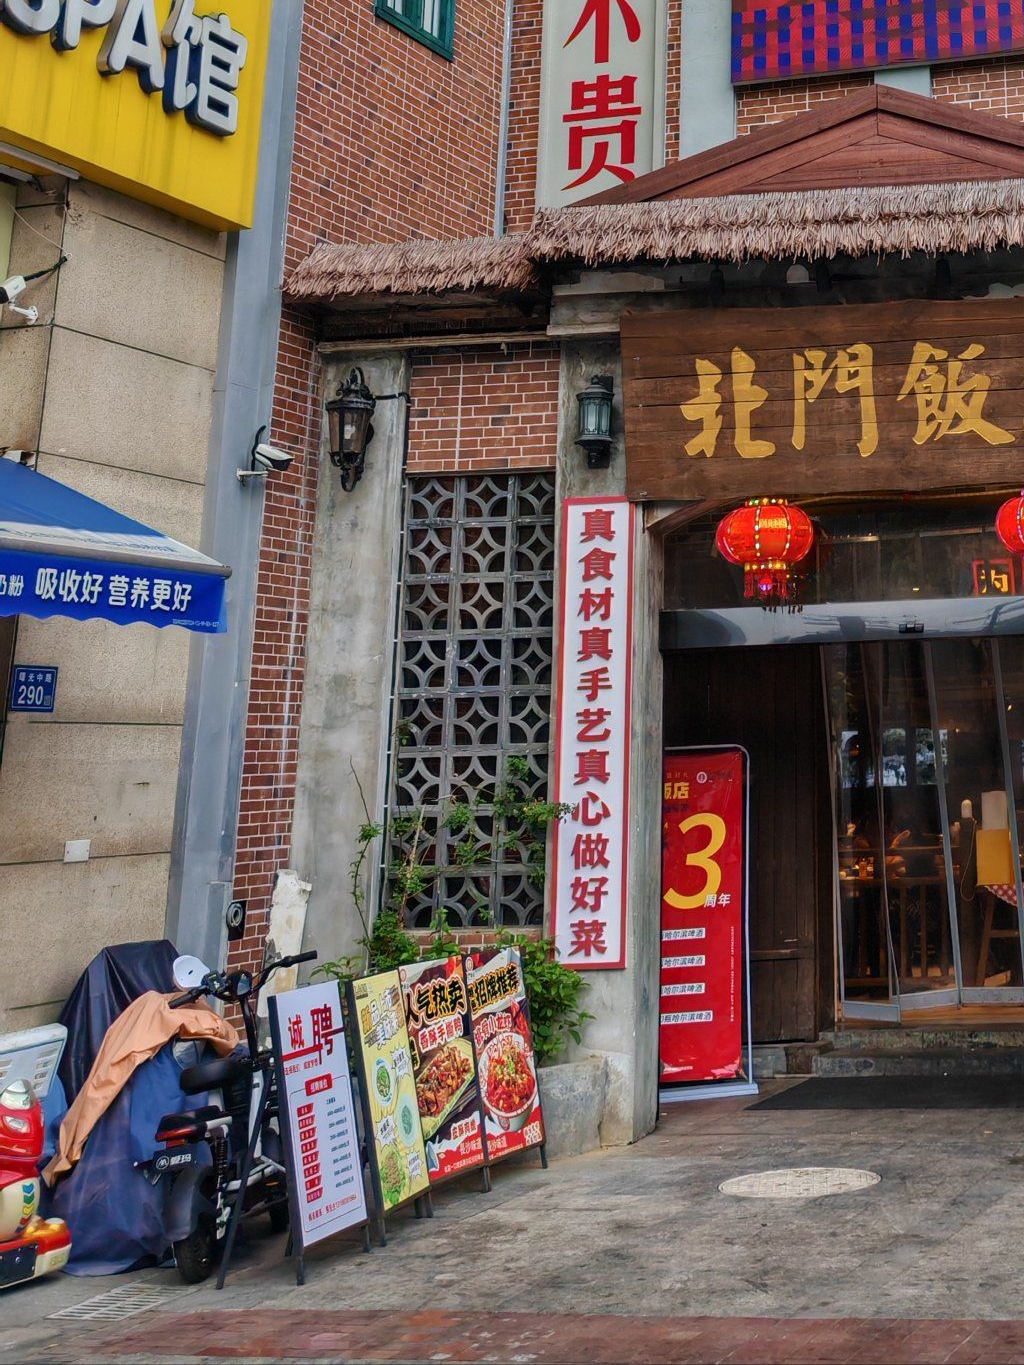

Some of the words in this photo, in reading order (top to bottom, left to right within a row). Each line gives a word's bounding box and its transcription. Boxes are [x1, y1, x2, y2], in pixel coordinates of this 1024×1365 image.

[35, 567, 104, 604] 吸收好
[108, 574, 193, 613] 营养更好
[17, 685, 44, 706] 290
[569, 508, 616, 957] 真食材真手艺真心做好菜
[663, 812, 727, 910] 3
[704, 893, 731, 908] 周年
[662, 928, 704, 940] 哈尔滨啤酒
[662, 956, 703, 967] 哈尔滨啤酒
[661, 984, 703, 995] 哈尔滨啤酒
[282, 1003, 345, 1065] 诚聘
